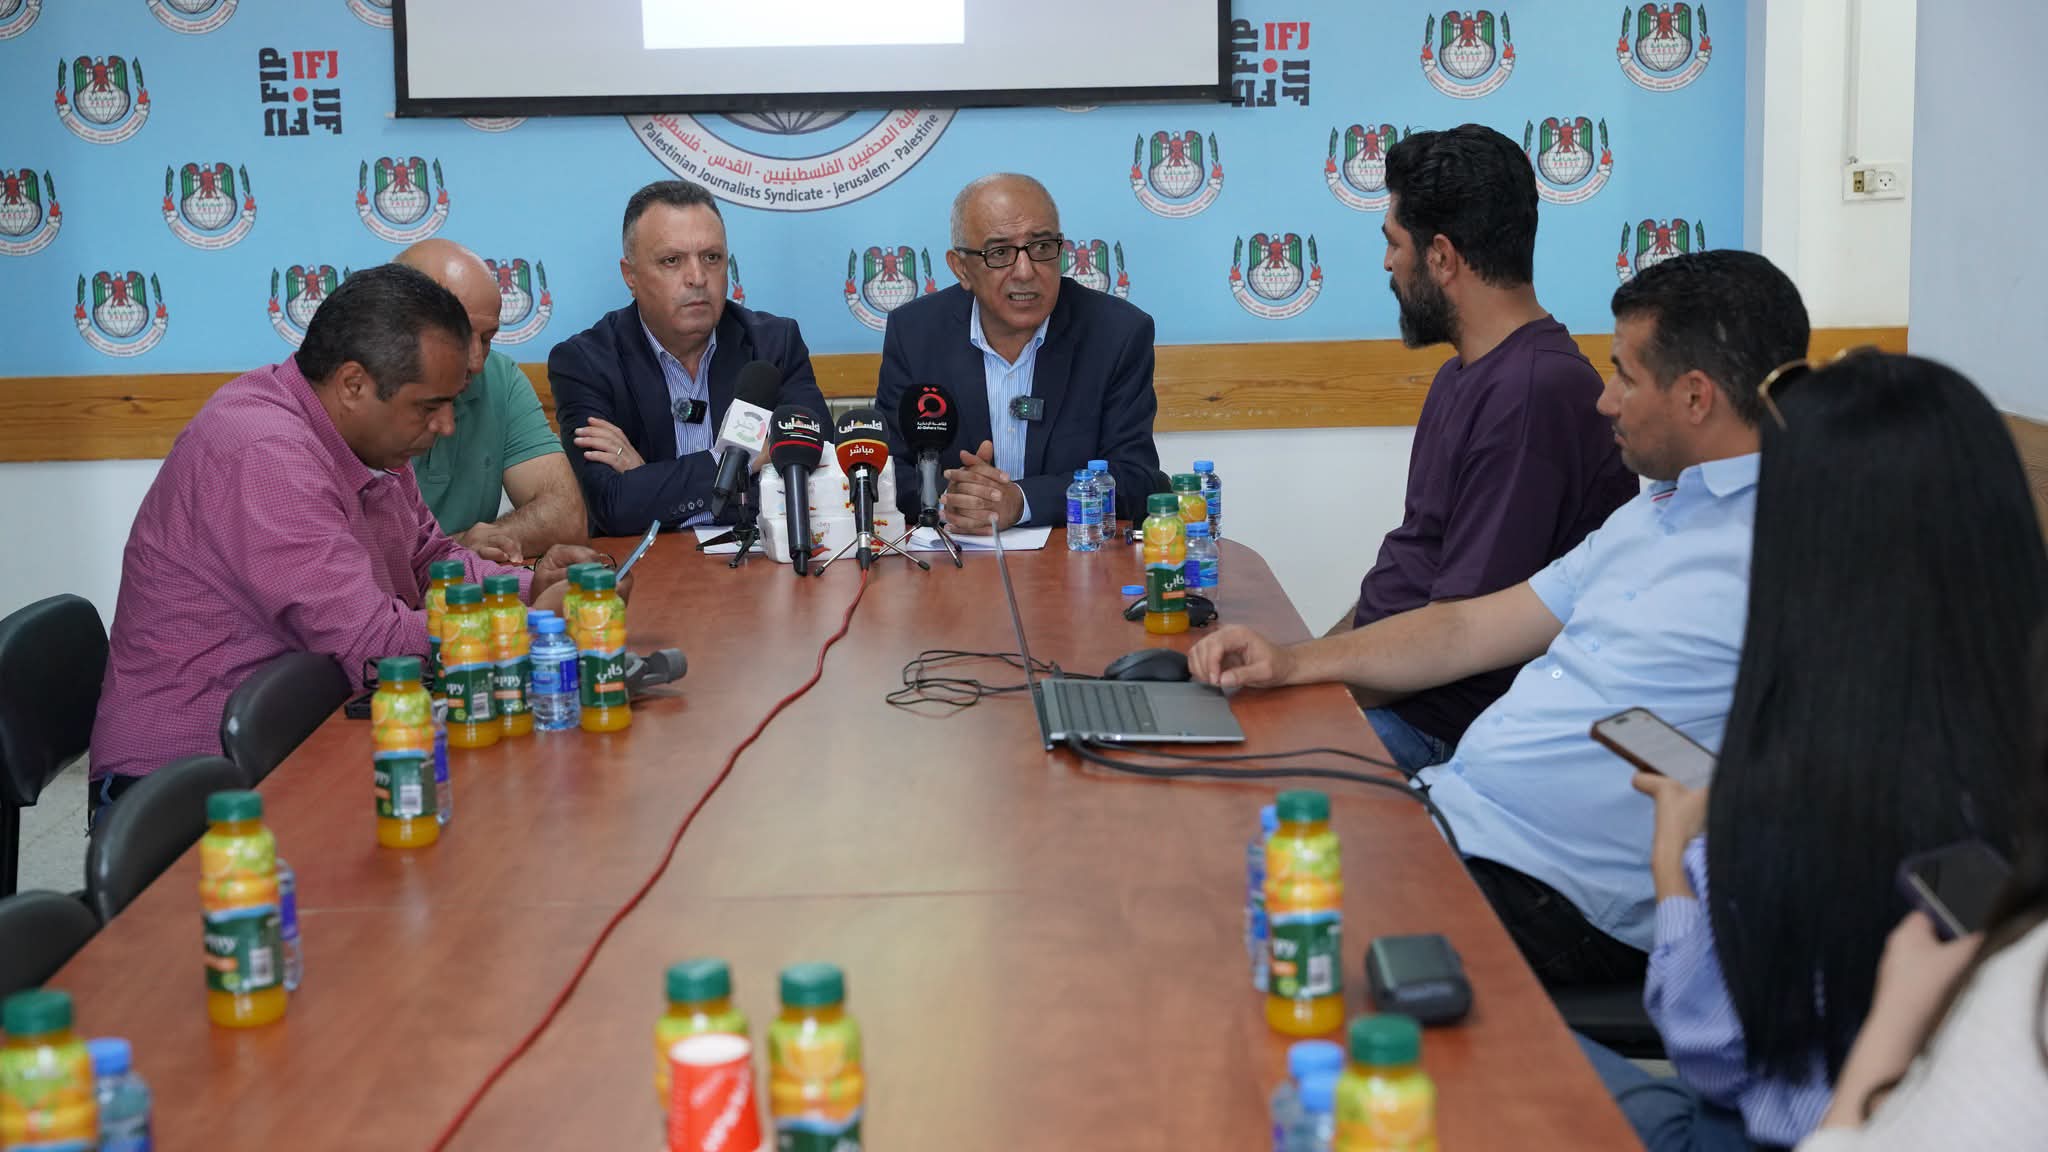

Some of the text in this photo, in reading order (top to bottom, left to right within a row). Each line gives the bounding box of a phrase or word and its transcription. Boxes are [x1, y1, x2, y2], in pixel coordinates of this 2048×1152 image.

[1264, 22, 1310, 51] IFJ
[259, 47, 289, 103] FIP
[292, 50, 338, 79] IFJ
[642, 121, 698, 174] Palestinian
[698, 168, 761, 199] Journalists
[764, 187, 823, 204] Syndicate
[834, 161, 890, 199] jerusalem
[894, 113, 939, 161] Palestine
[848, 124, 900, 171] الصحفيين
[707, 155, 752, 177] القدس
[763, 158, 845, 185] الفلسطينيين
[850, 444, 875, 457] مباشر
